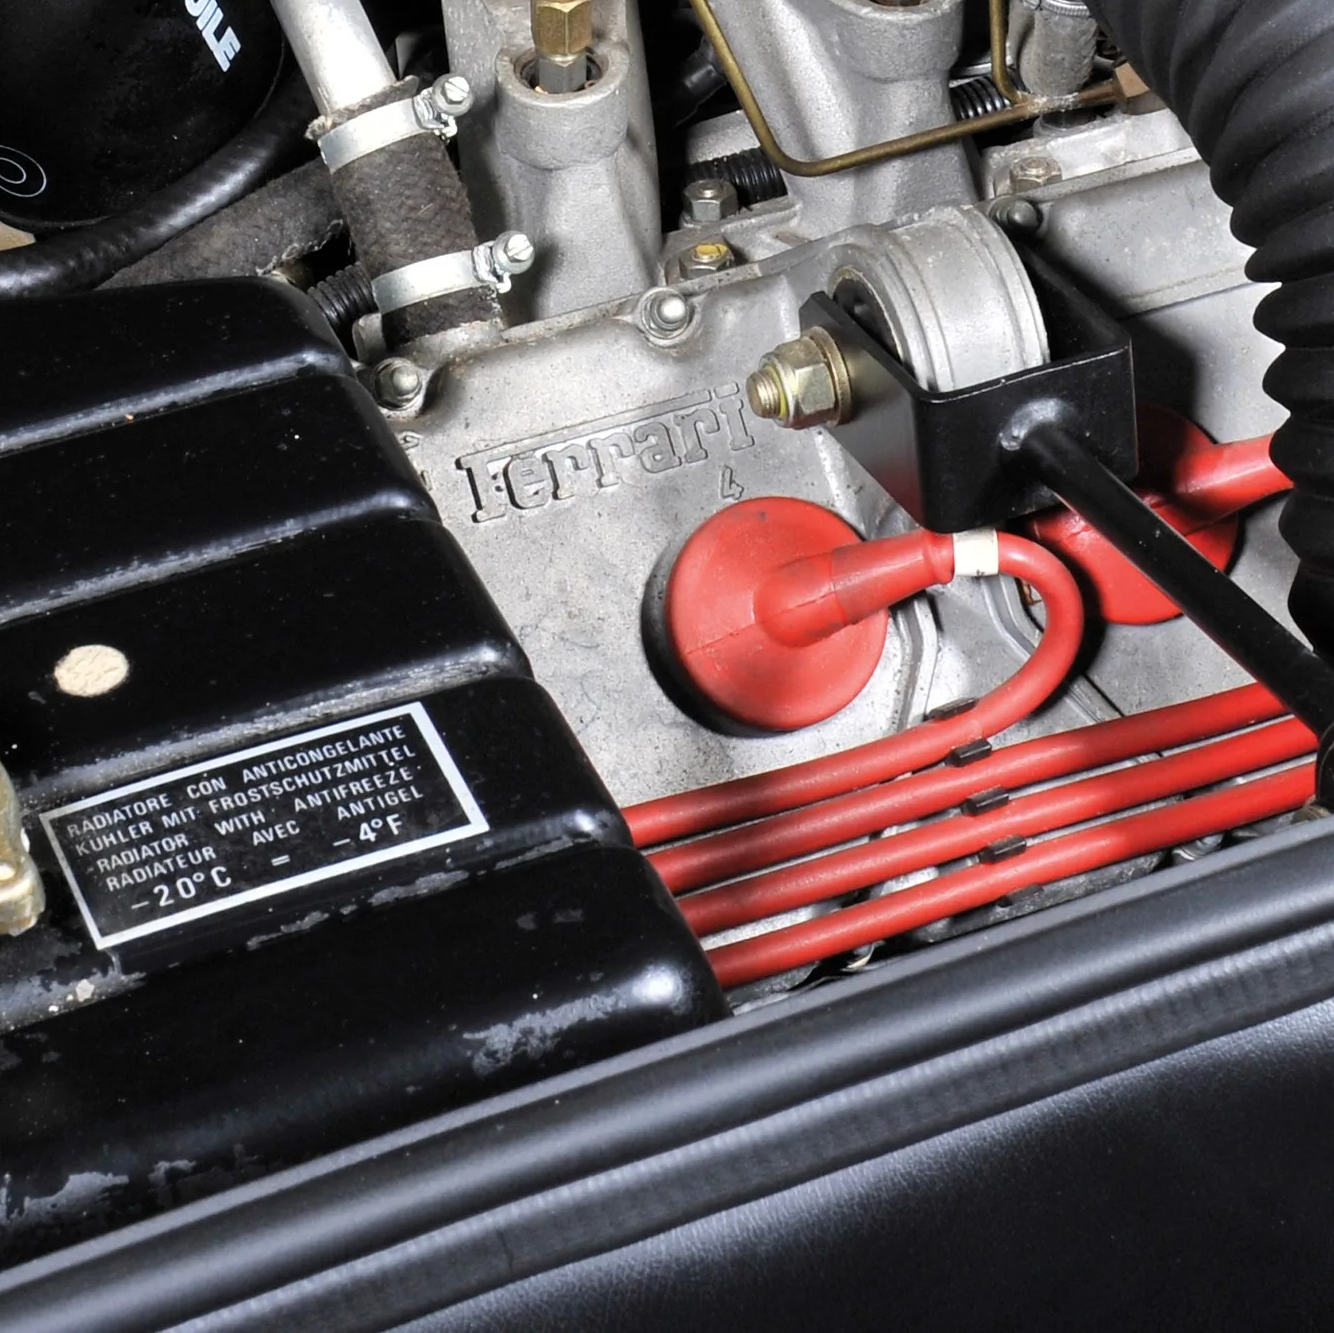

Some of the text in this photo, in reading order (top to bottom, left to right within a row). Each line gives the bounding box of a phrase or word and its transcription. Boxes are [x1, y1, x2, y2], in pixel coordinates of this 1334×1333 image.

[455, 382, 756, 523] Ferrari
[67, 724, 407, 838] RADIATORE CON ANTICONGELANTE
[75, 744, 417, 857] KUHLER MIT FROSTSCHUTZMITTEL
[96, 767, 415, 874] RADIATOR WITH ANTIFREEZE
[106, 785, 425, 892] RADIATEUR AVEC ANTIGEL
